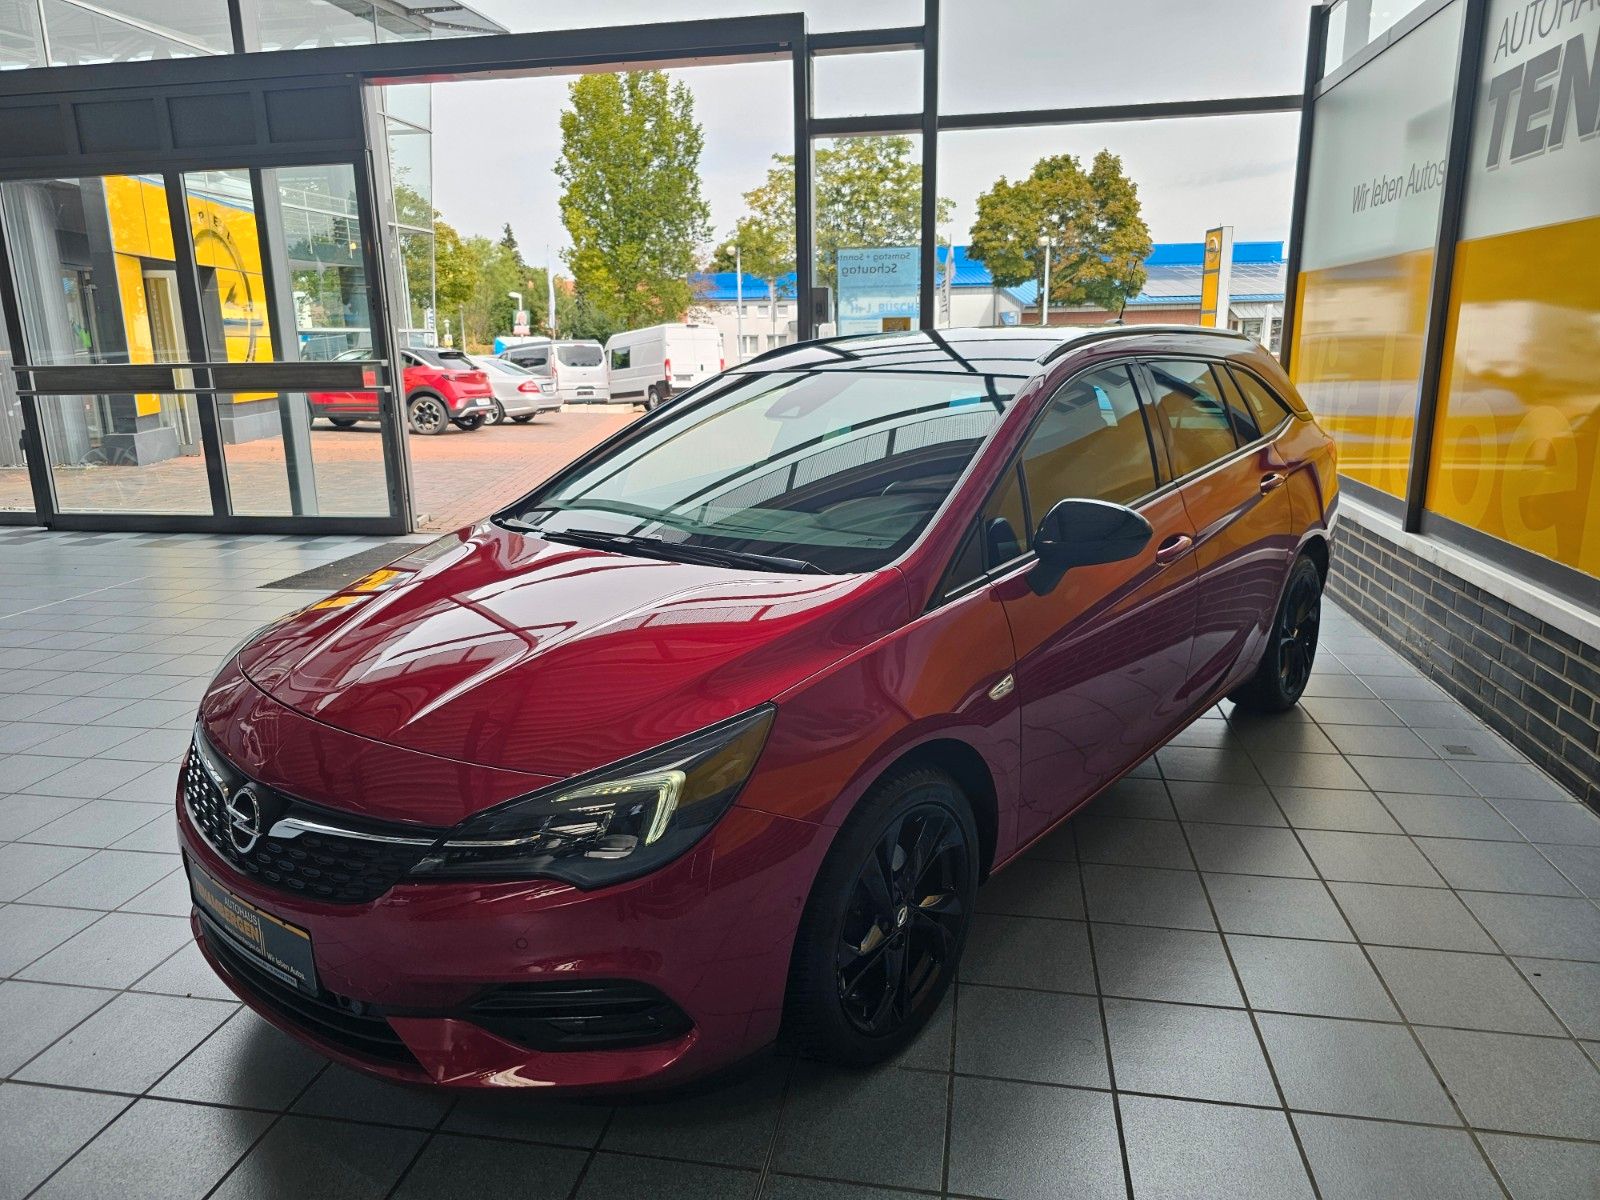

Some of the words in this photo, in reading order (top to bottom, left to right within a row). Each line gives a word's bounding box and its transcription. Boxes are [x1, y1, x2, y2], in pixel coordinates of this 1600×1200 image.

[1352, 183, 1370, 214] Wir
[1371, 174, 1403, 208] leben
[224, 897, 258, 925] AUTOHAUS
